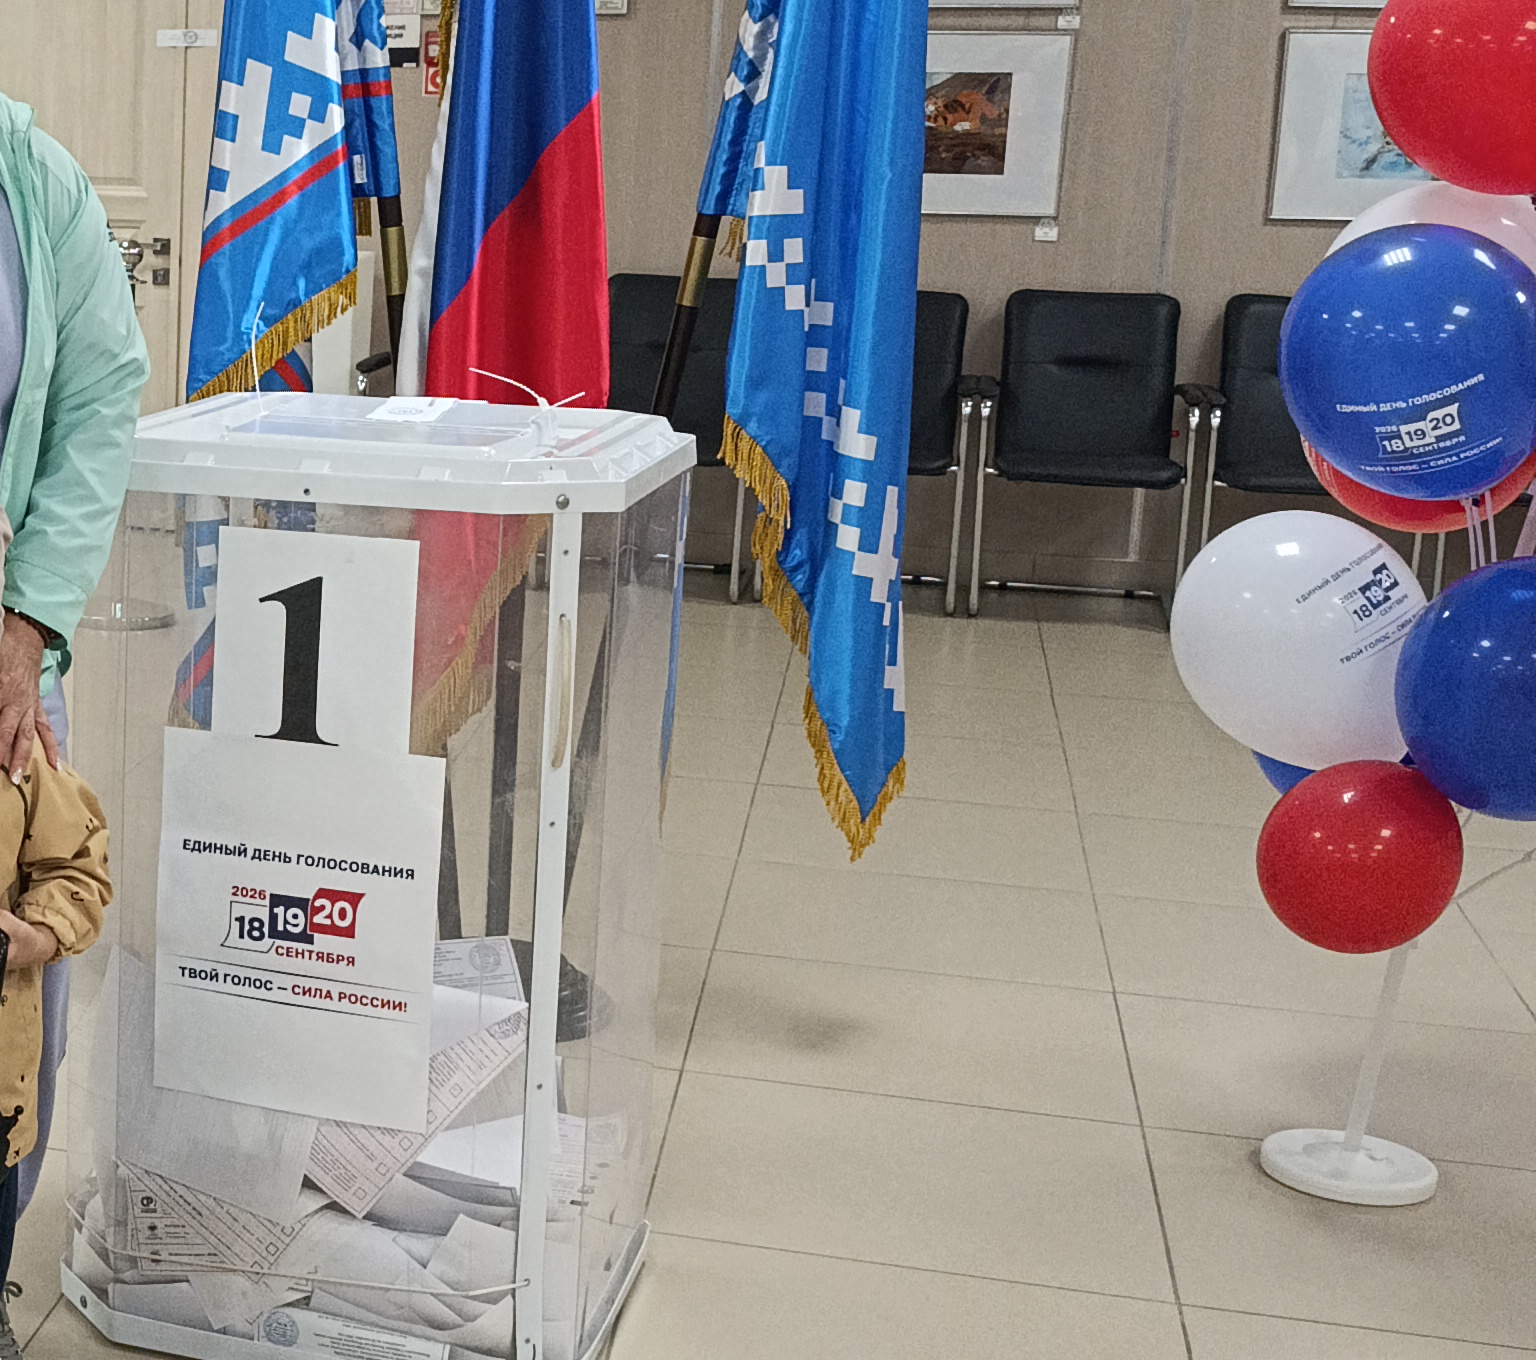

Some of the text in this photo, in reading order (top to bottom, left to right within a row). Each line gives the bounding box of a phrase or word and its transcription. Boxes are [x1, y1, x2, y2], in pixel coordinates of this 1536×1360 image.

[1335, 373, 1485, 413] ЕДИНЫЙ ДЕНЬ ГОЛОСОВАНИЯ
[1429, 413, 1456, 431] 20
[1381, 438, 1405, 453] 18
[1404, 427, 1427, 443] 19
[1412, 435, 1466, 454] СЕНТЯБРЯ
[1375, 569, 1395, 589] 20
[1365, 585, 1385, 604] 19
[1352, 603, 1373, 621] 18
[1339, 647, 1364, 664] ТВОЙ
[1364, 631, 1391, 652] ГОЛОС
[254, 575, 339, 747] 1
[182, 838, 416, 880] ЕДИНЫЙ ДЕНЬ ГОЛОСОВАНИЯ
[231, 885, 267, 901] 2026
[273, 905, 306, 934] 19
[312, 897, 354, 928] 20
[234, 915, 266, 941] 18
[275, 945, 356, 967] СЕНТЯБРЯ
[178, 965, 219, 983] ТВОЙ
[223, 973, 274, 991] ГОЛОС
[291, 984, 334, 1001] СИЛА
[338, 992, 408, 1013] РОССИИ!
